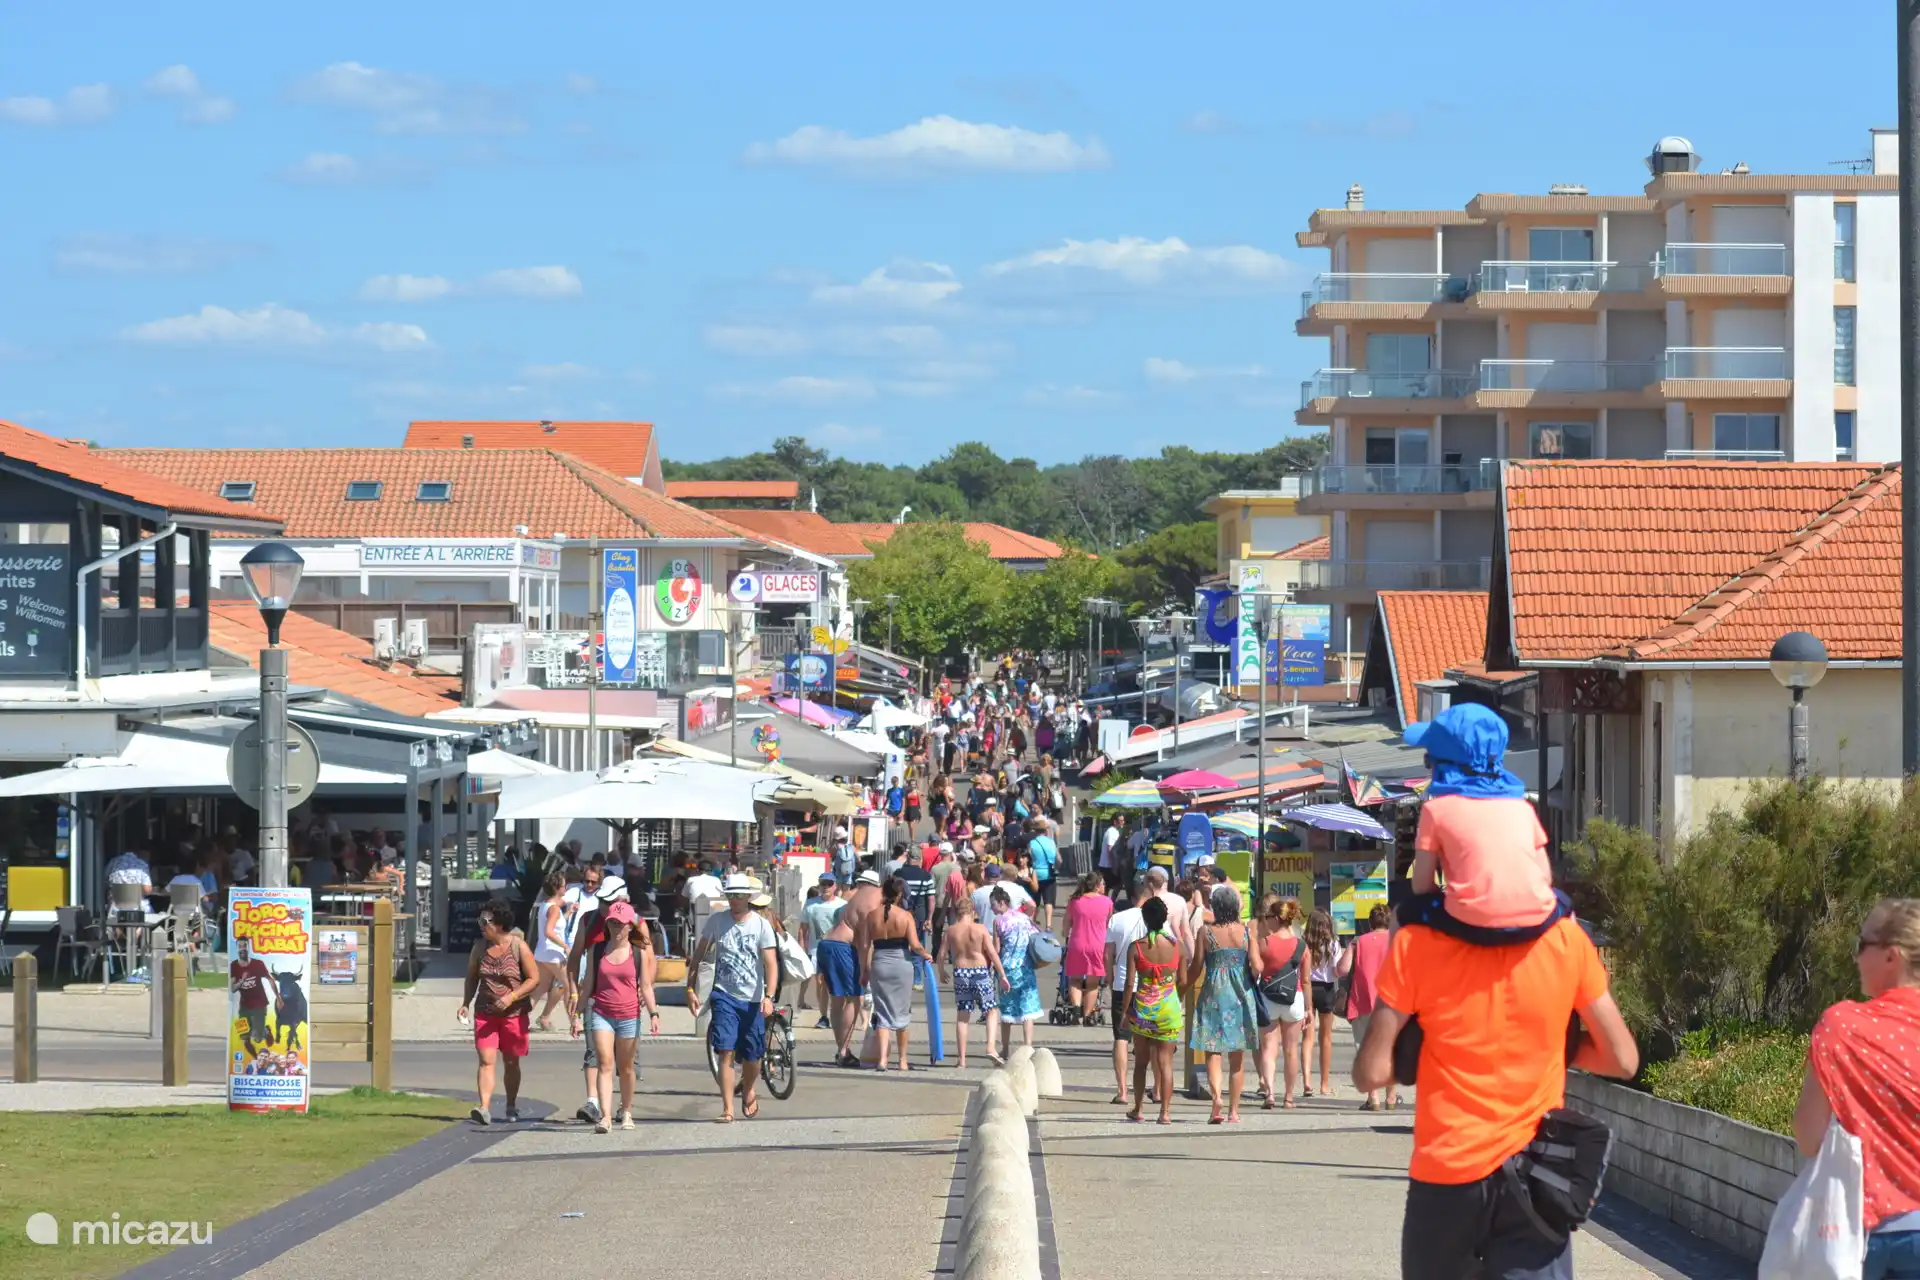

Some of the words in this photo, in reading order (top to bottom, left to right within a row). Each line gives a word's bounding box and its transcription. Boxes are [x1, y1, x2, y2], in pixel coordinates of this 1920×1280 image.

[365, 545, 421, 561] ENTRÉE
[424, 545, 434, 561] À
[438, 546, 446, 561] L
[0, 556, 63, 571] sserie
[764, 575, 817, 592] GLACES
[19, 594, 65, 617] Welcome
[661, 596, 698, 619] PIZZA
[1264, 857, 1313, 872] OCATION
[1271, 882, 1301, 896] SURF
[252, 933, 307, 953] LABAT
[234, 1078, 300, 1087] BISCARROSSE
